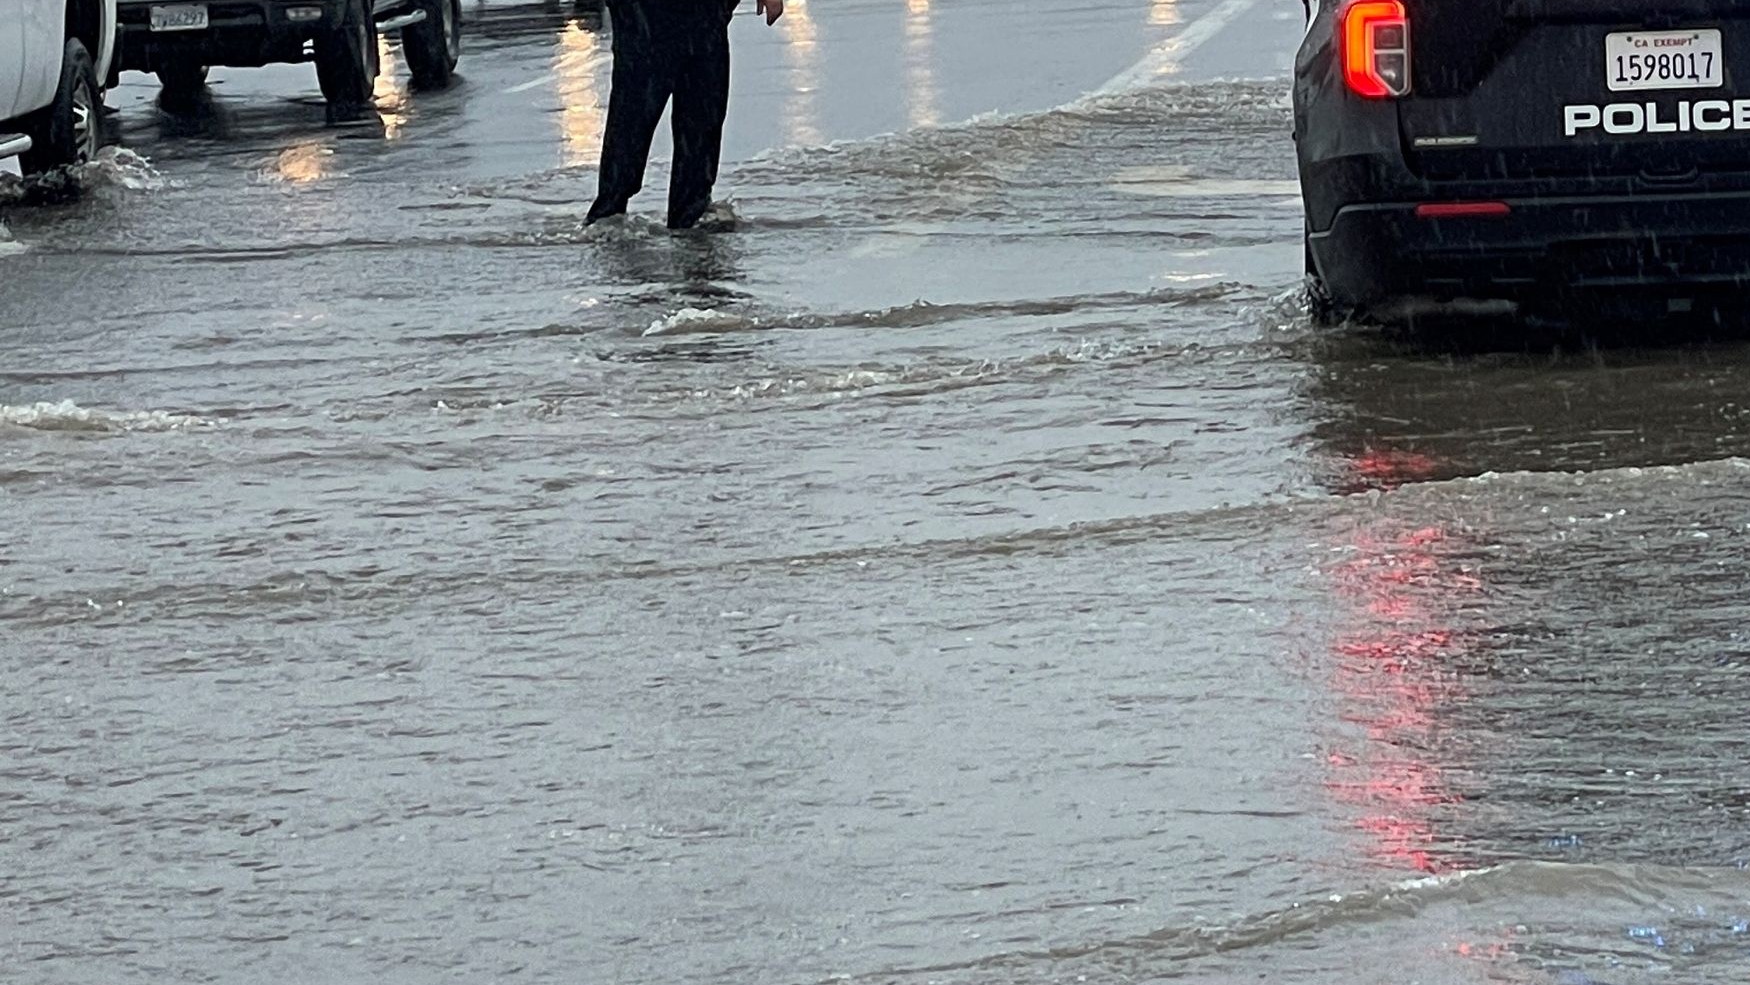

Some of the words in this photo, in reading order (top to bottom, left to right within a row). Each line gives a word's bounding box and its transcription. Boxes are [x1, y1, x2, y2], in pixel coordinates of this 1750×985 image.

[1634, 39, 1649, 48] CA
[1654, 37, 1694, 48] EXEMPT
[1615, 52, 1714, 82] 1598017
